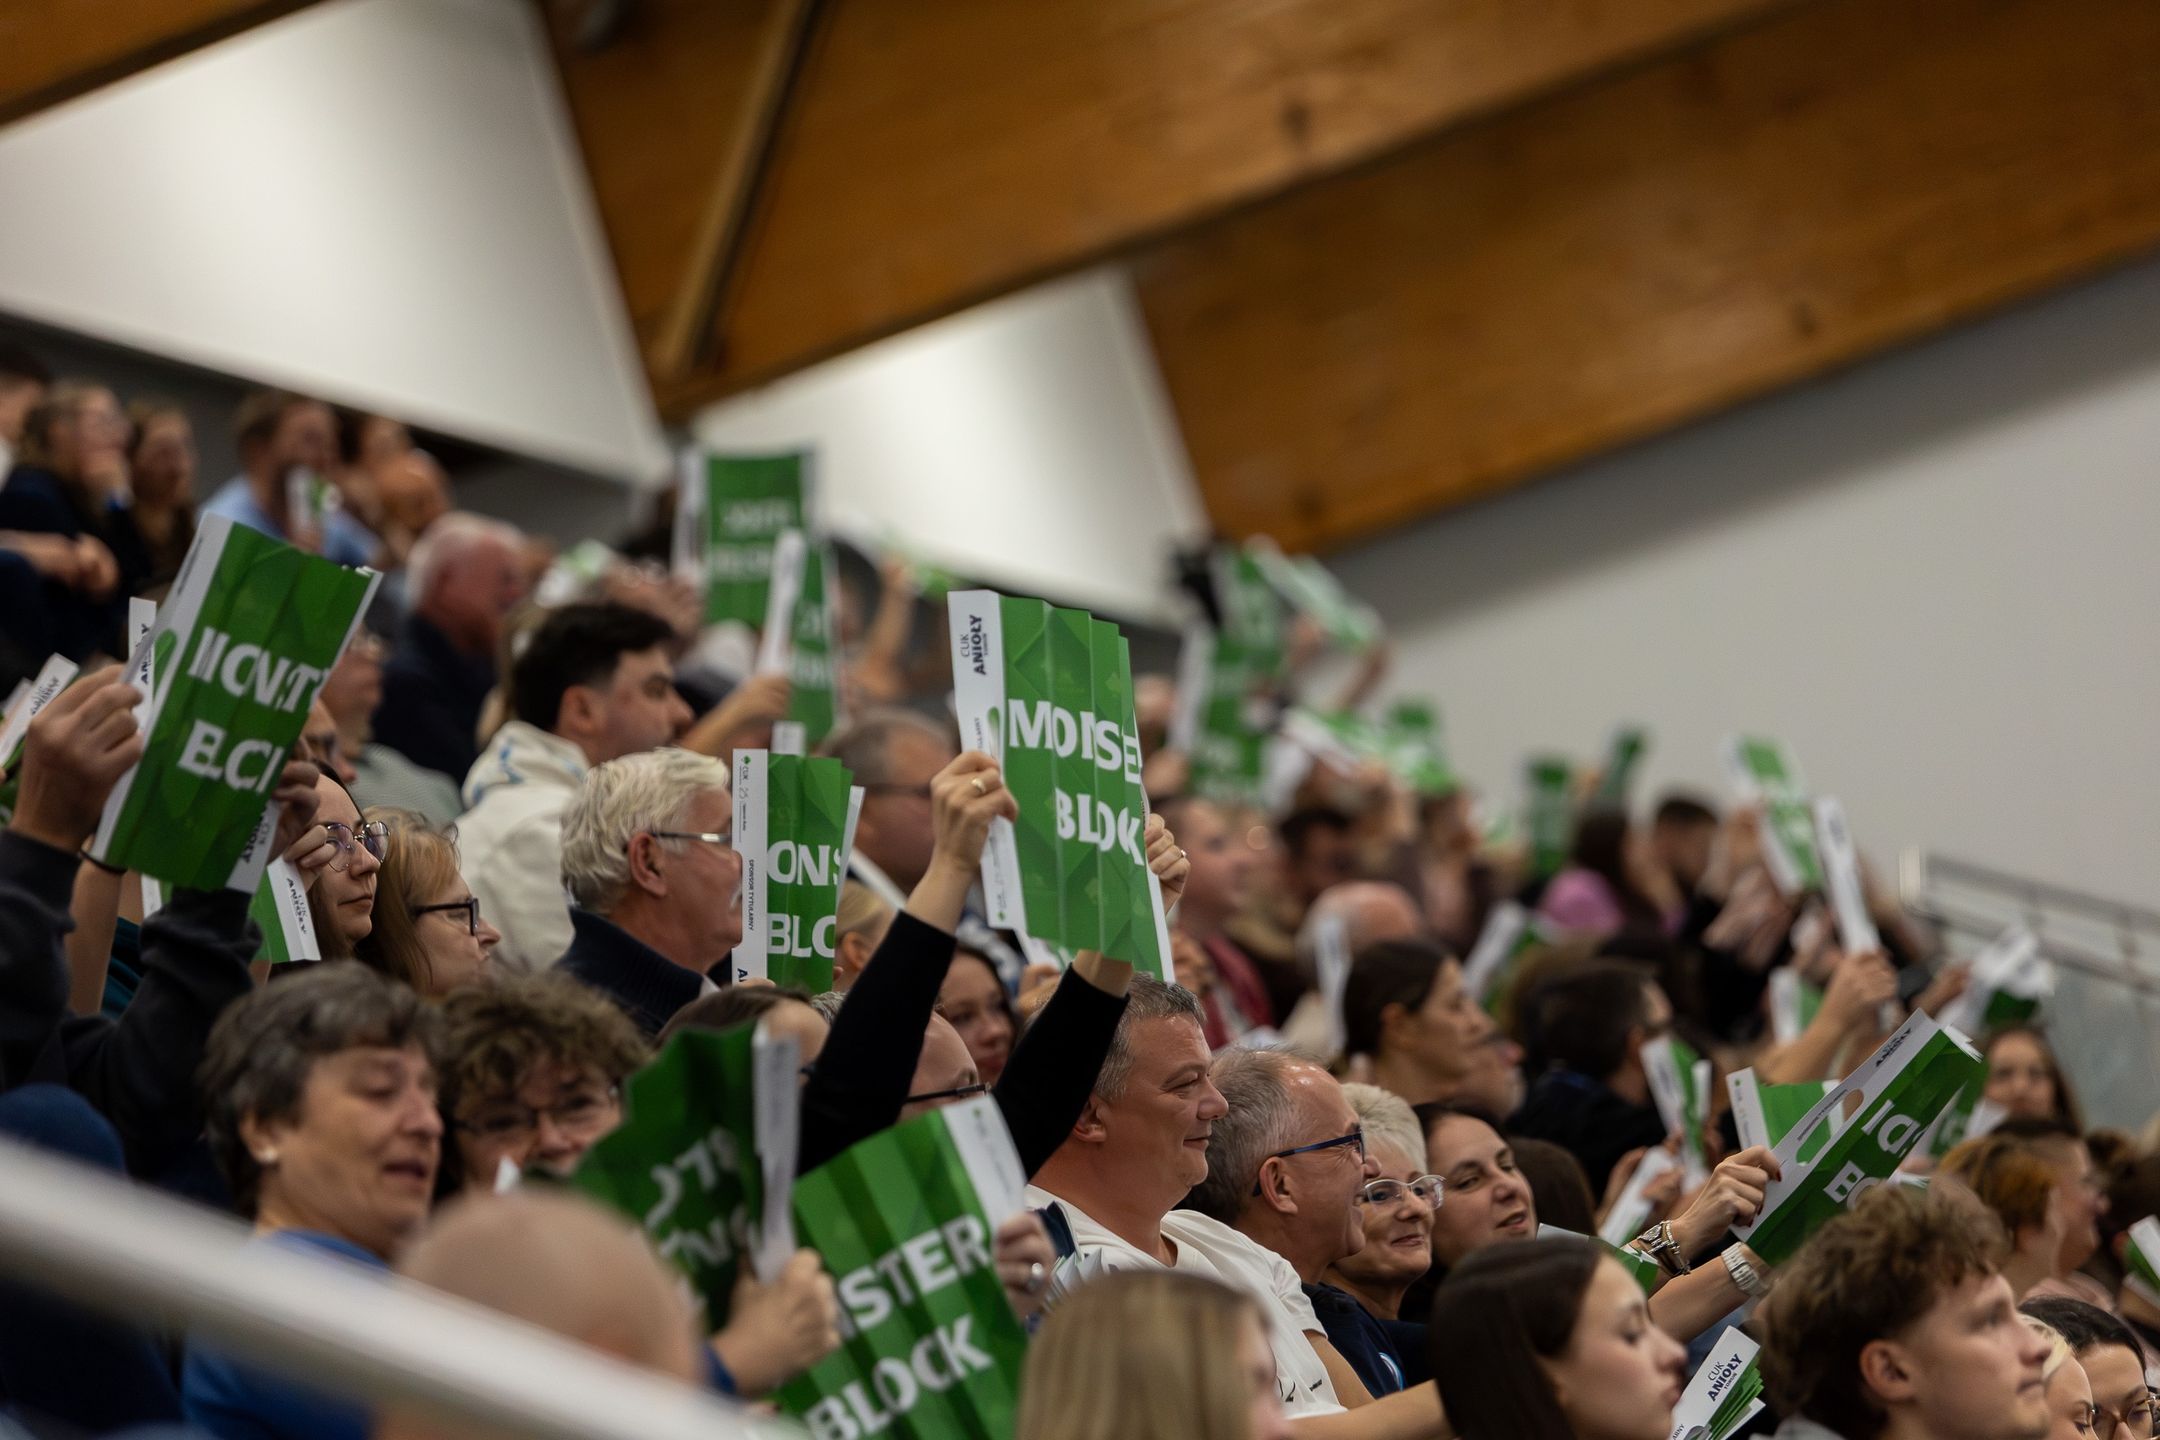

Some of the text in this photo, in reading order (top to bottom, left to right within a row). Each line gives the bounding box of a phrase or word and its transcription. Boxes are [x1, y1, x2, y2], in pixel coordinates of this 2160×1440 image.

[960, 634, 970, 658] CUK
[969, 614, 987, 675] ANIOŁY
[837, 1214, 991, 1339] STER
[804, 1313, 994, 1440] BLOCK
[1707, 1361, 1725, 1381] CUK
[1707, 1353, 1742, 1402] ANIOŁY
